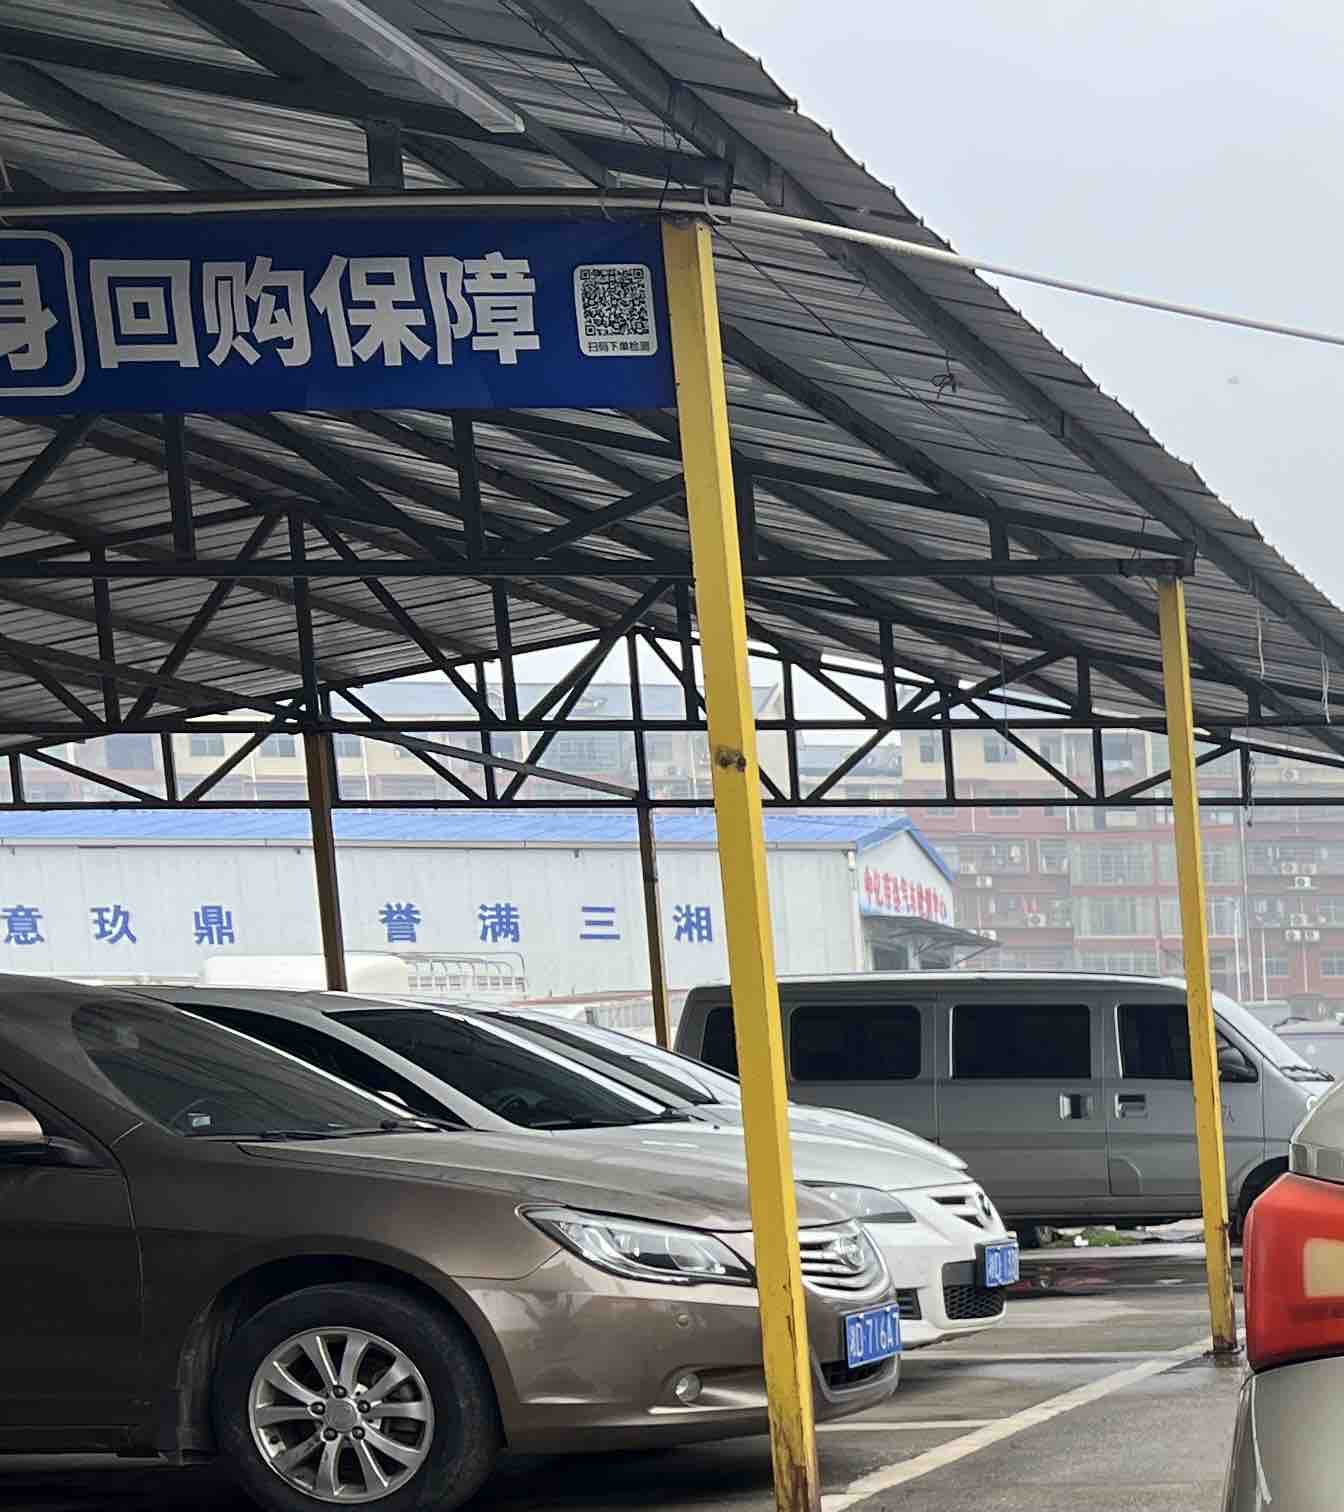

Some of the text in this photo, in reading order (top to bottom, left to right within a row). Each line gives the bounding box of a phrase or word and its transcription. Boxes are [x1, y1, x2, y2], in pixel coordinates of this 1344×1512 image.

[89, 252, 540, 368] 回购保障
[378, 902, 715, 944] 誉满三湘
